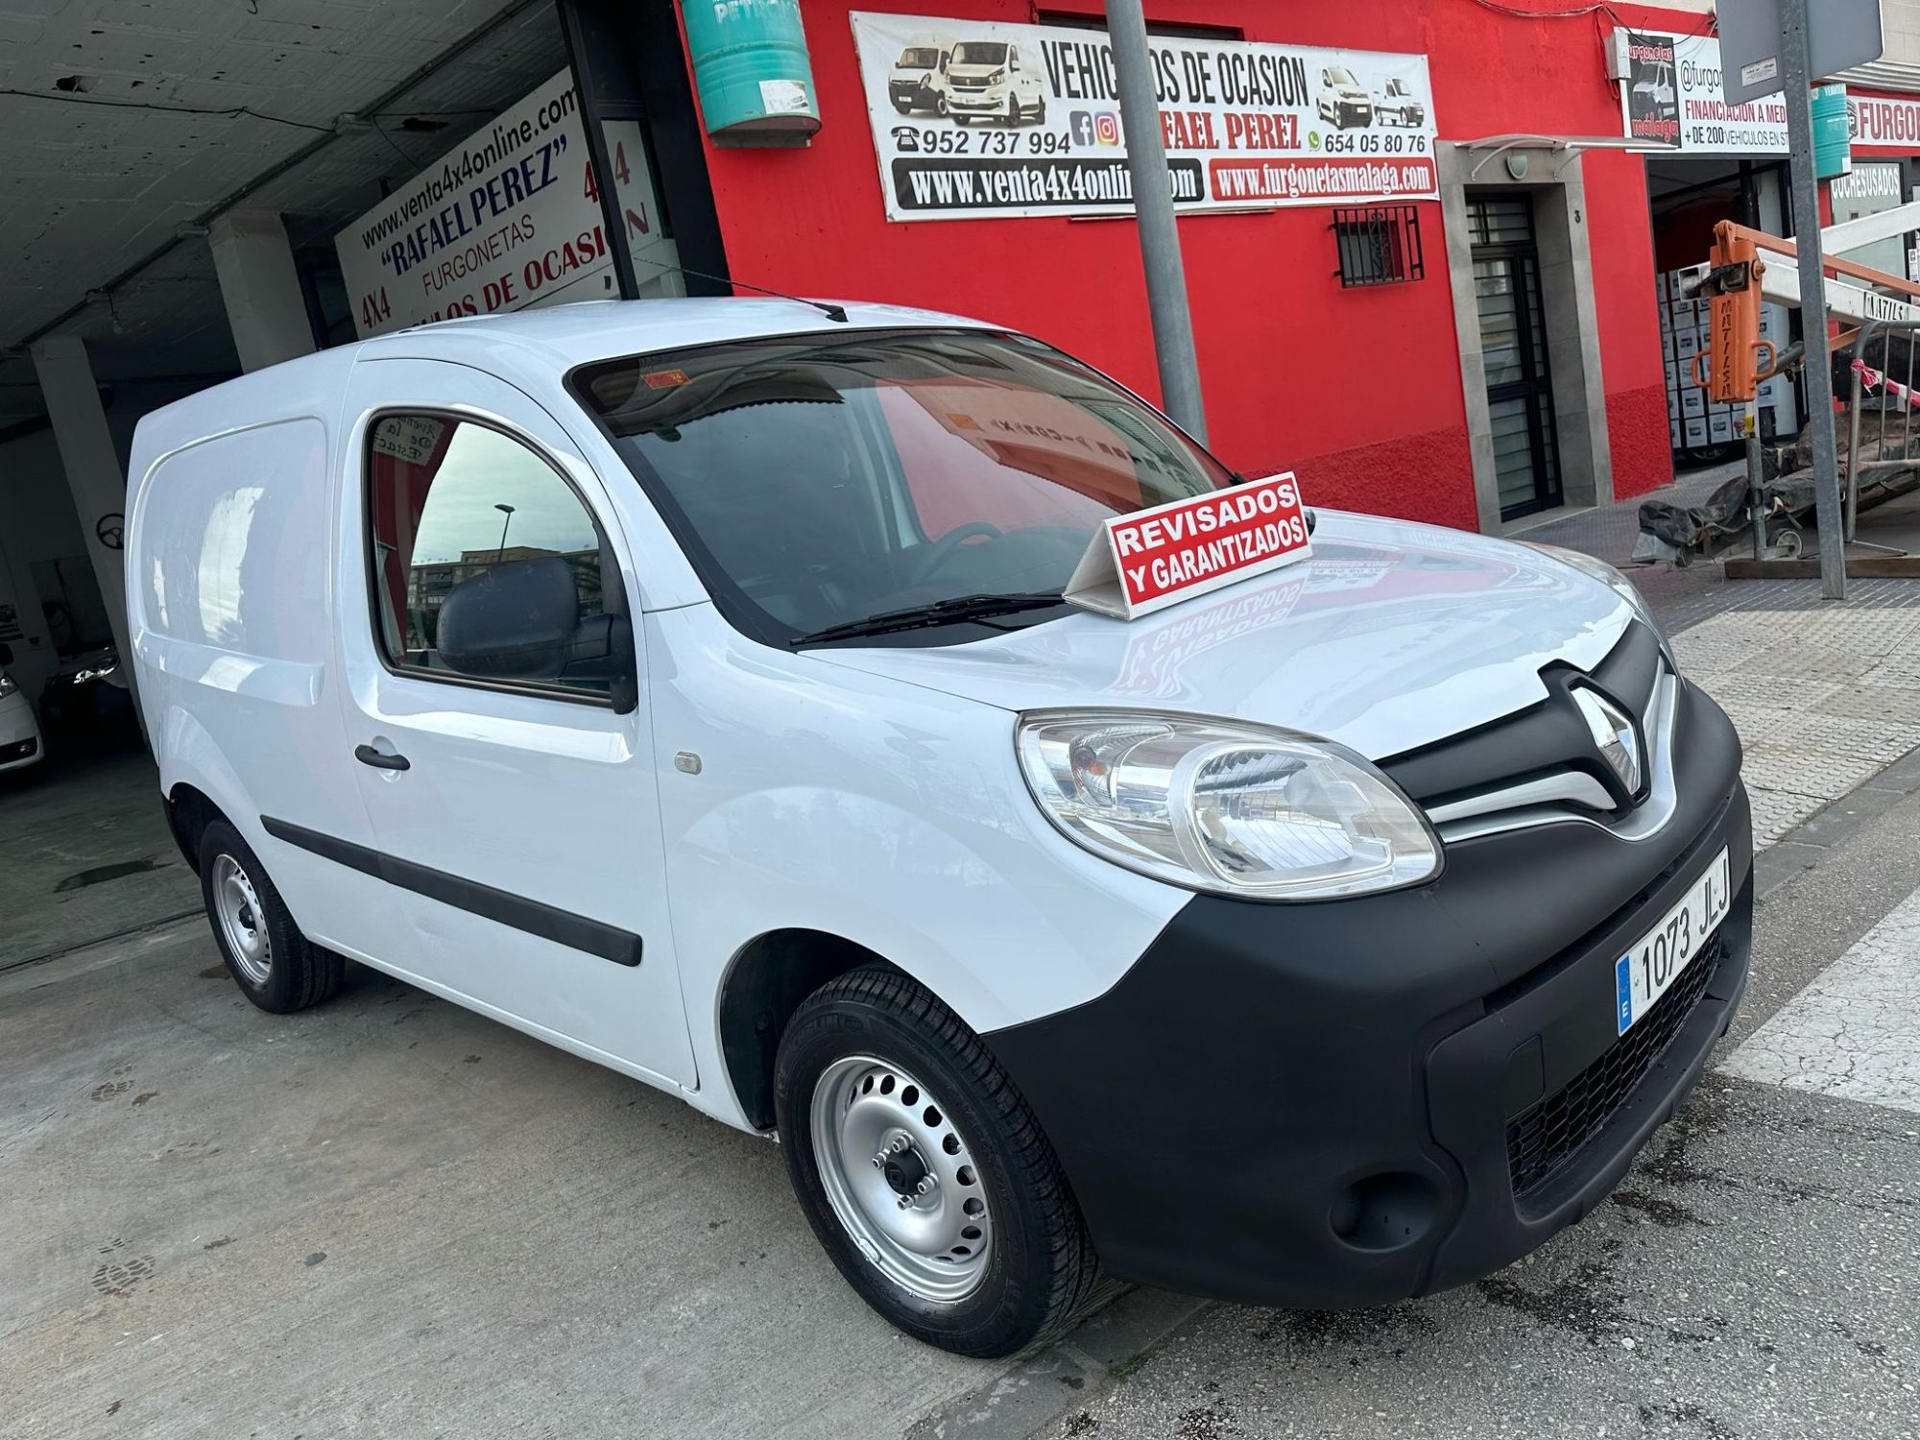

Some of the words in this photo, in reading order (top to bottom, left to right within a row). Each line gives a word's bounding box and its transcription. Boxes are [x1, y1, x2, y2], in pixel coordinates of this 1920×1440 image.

[1041, 40, 1180, 103] VEHICOS
[1181, 51, 1216, 104] DE
[1218, 53, 1309, 107] OCASION
[1629, 43, 1673, 65] urgonetas
[1681, 60, 1722, 93] @furgo
[1119, 111, 1219, 150] FAEL
[1224, 112, 1302, 150] PEREZ
[1685, 100, 1755, 123] FINANCIACION
[1758, 104, 1765, 122] A
[1858, 102, 1920, 141] FURGO
[923, 130, 969, 154] 952
[979, 131, 1021, 155] 737
[1029, 132, 1070, 155] 994
[1325, 134, 1354, 153] 654
[1360, 134, 1379, 153] 05
[1384, 134, 1402, 153] 80
[1408, 135, 1425, 153] 76
[1692, 126, 1704, 143] DE
[1707, 126, 1724, 144] 200
[1725, 130, 1768, 145] VEHICULOS
[909, 164, 1197, 204] www.venta4x4onliom
[1217, 162, 1431, 198] www.furgonetasmalaga.com
[422, 214, 536, 296] FURGONETAS
[483, 272, 519, 313] DE
[524, 202, 650, 291] OCASIN
[362, 286, 391, 329] 4X4
[1115, 484, 1296, 557] REVISADOS
[1127, 565, 1146, 593] Y
[1151, 515, 1303, 590] GARANTIZADOS
[1642, 906, 1690, 1000] 1073
[1699, 858, 1727, 935] JLJ
